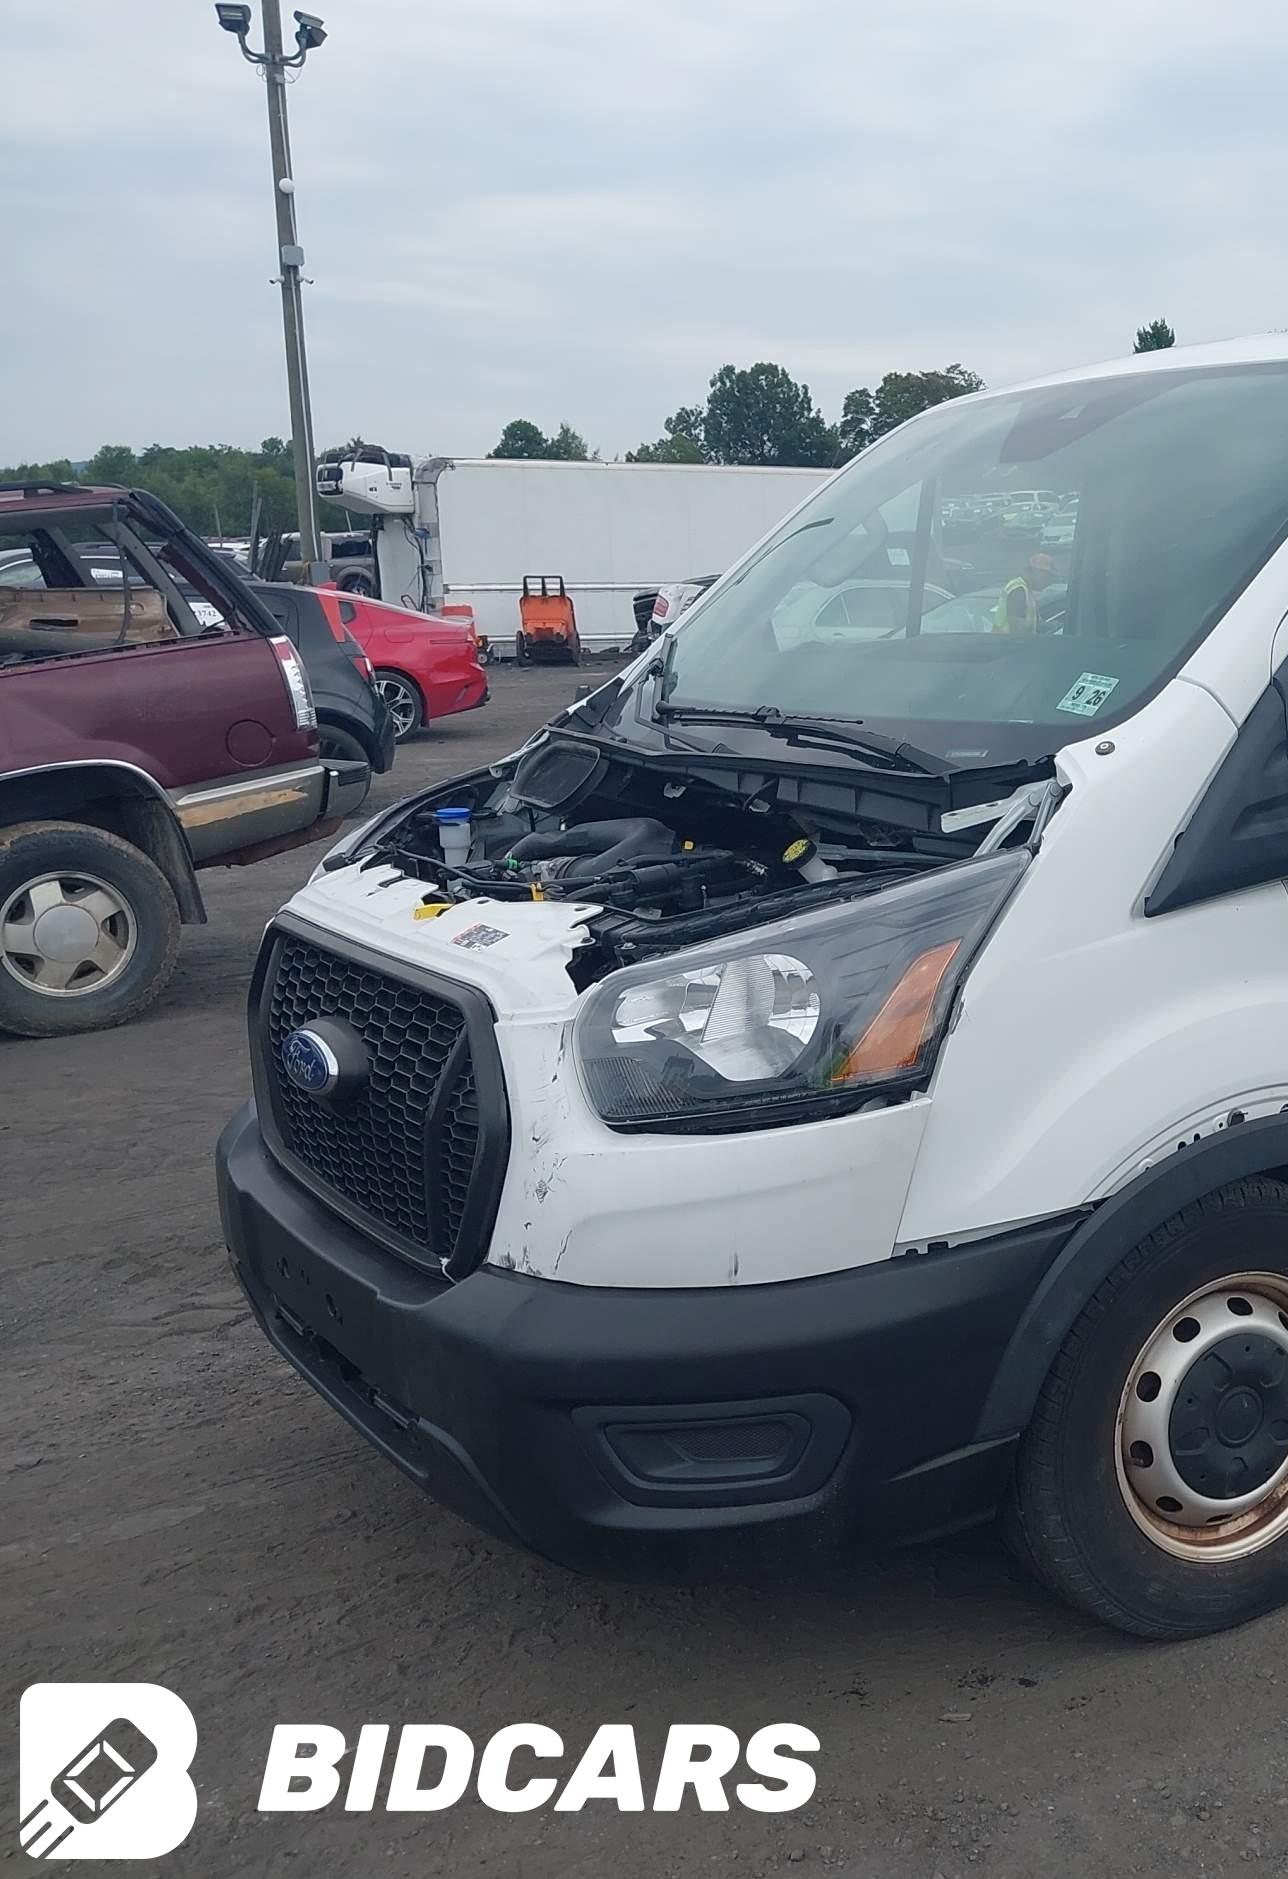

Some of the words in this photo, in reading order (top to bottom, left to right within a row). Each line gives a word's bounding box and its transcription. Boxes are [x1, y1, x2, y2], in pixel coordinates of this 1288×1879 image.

[1072, 686, 1085, 700] 9
[1086, 690, 1106, 706] 26
[287, 1040, 316, 1081] Ford
